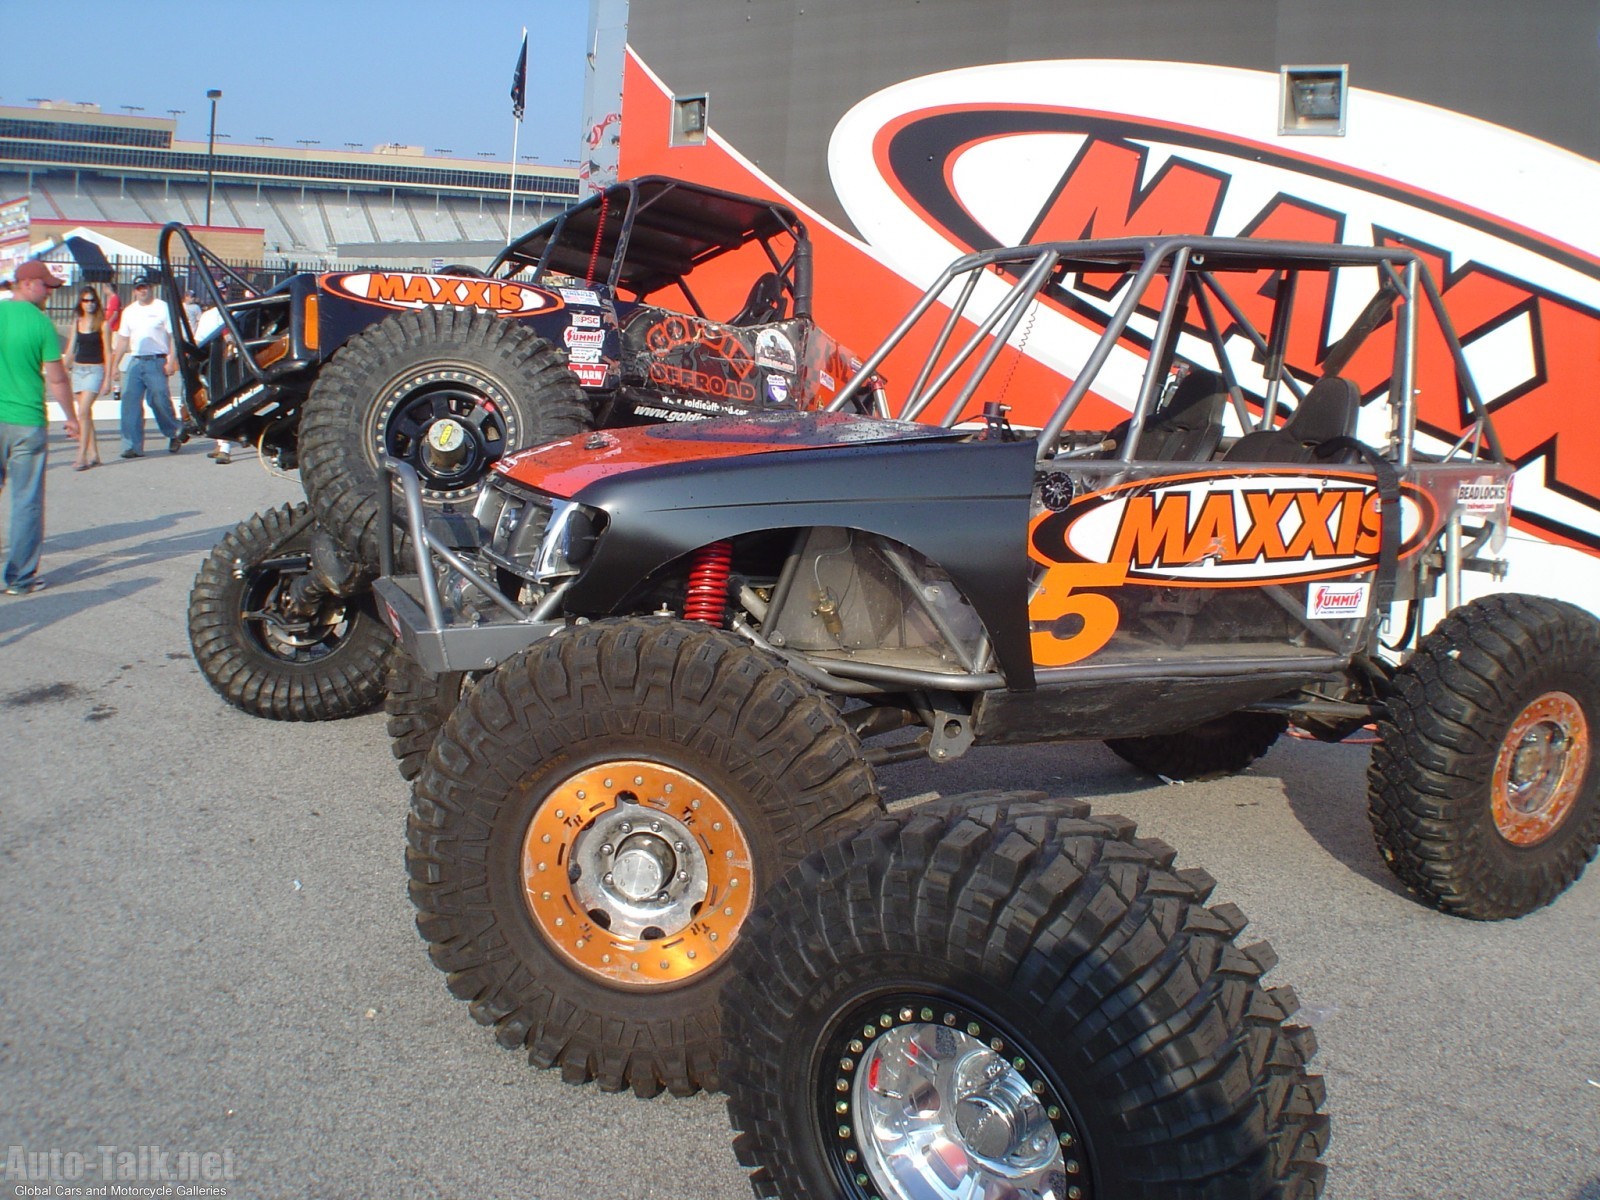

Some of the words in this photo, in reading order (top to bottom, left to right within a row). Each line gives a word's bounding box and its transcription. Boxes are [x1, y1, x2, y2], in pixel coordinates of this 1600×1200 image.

[366, 273, 524, 311] MAXXIS
[580, 316, 599, 325] PSC
[651, 362, 756, 401] OFFROAD
[1028, 561, 1131, 667] 5
